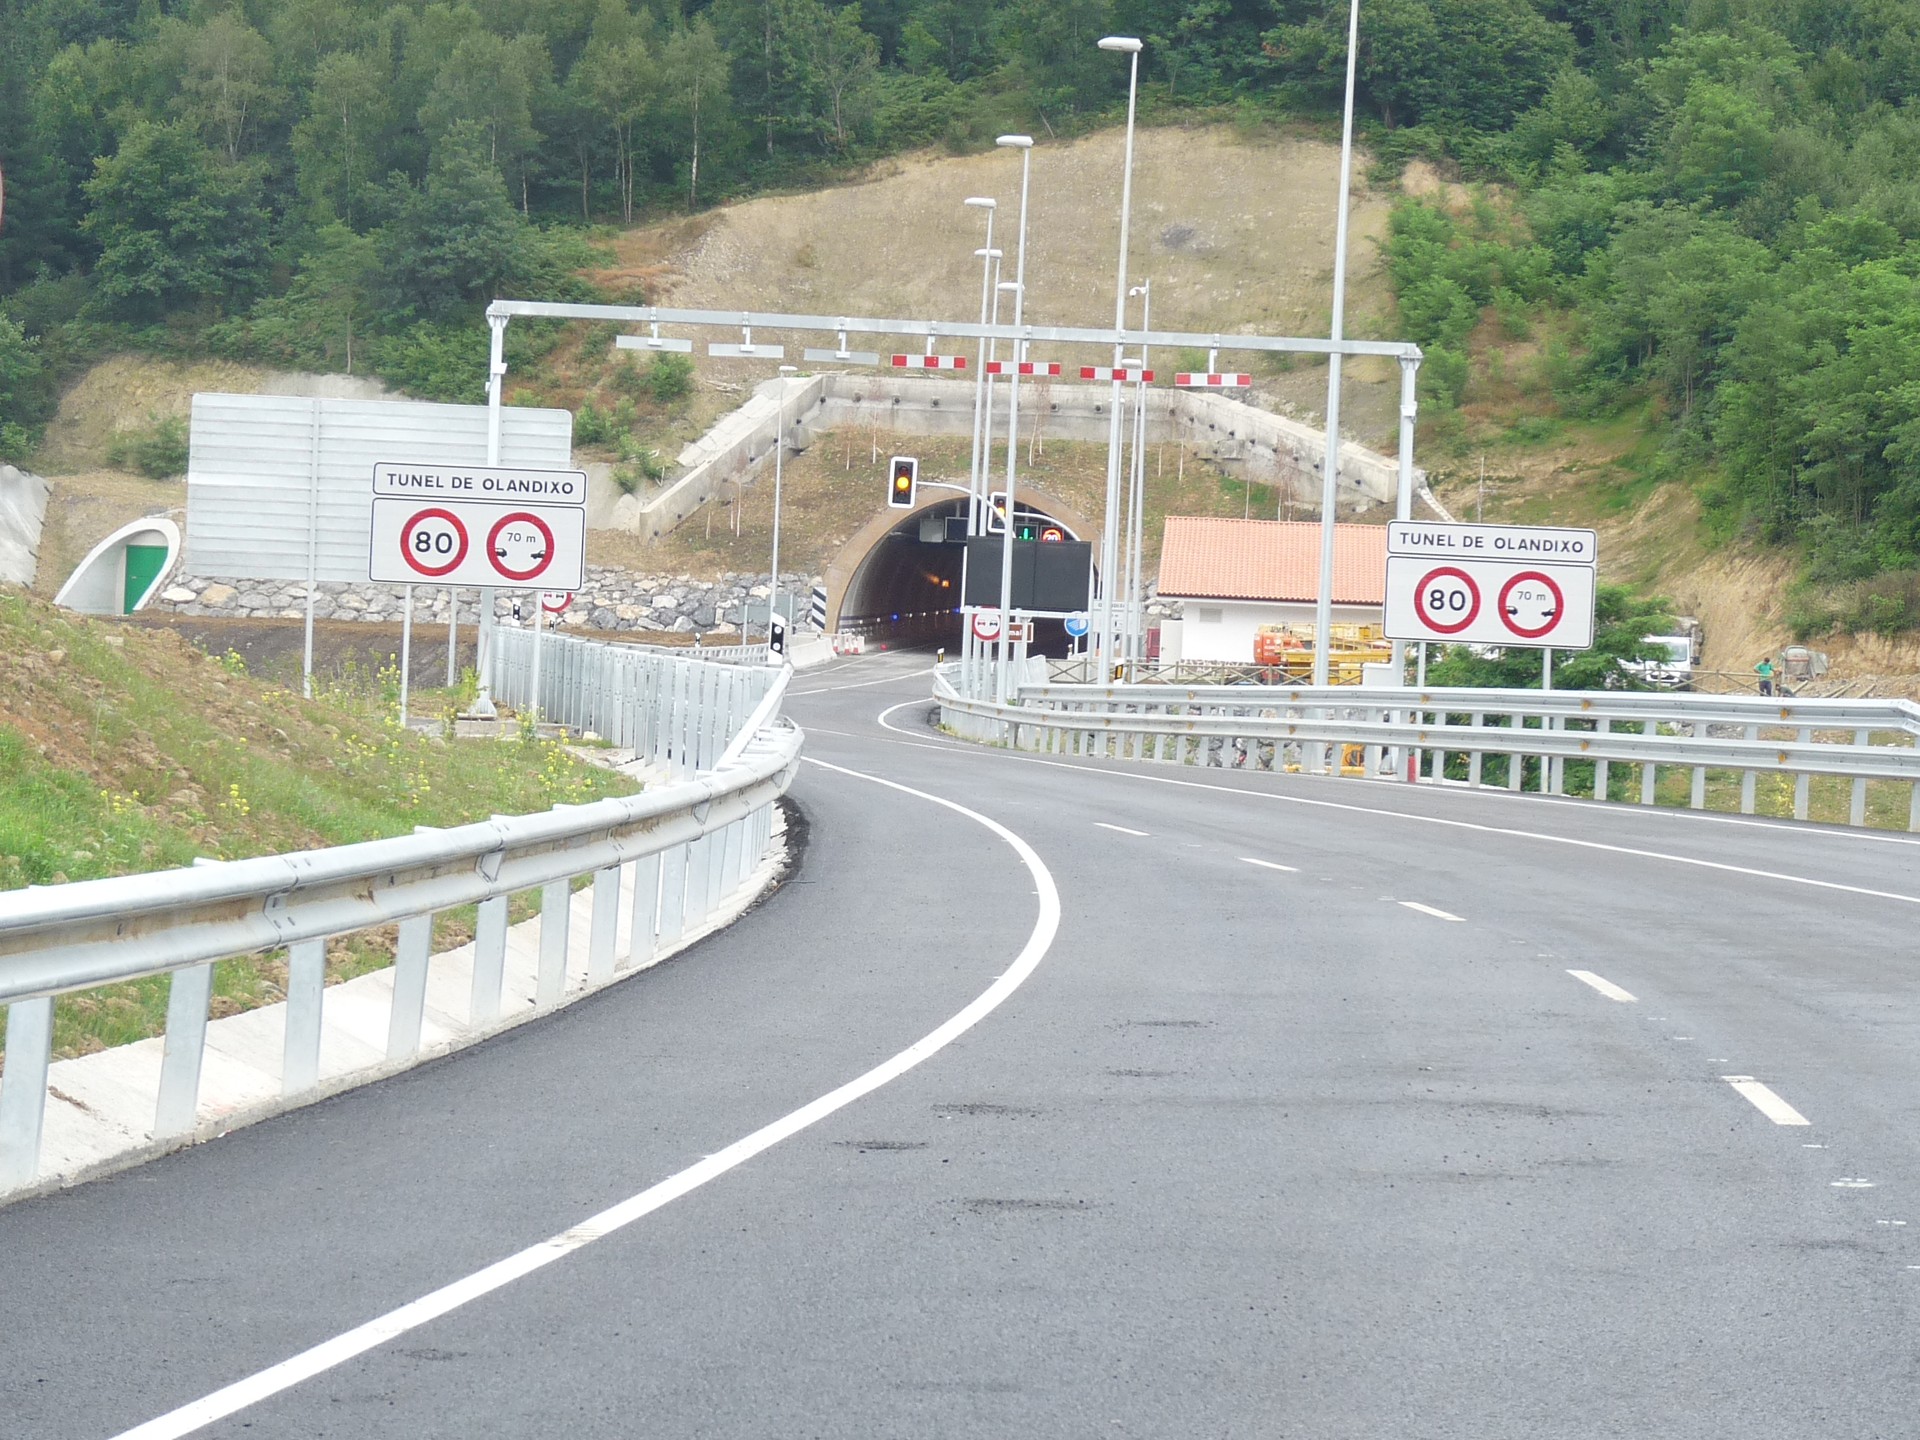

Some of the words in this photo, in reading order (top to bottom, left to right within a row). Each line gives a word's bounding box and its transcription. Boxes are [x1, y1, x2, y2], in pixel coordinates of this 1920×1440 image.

[386, 473, 445, 489] TUNEL
[451, 476, 473, 490] DE
[482, 478, 574, 495] OLANDIXO
[414, 531, 453, 554] 80
[506, 532, 522, 542] 70
[525, 535, 536, 543] m
[1399, 532, 1456, 547] TUNEL
[1462, 535, 1484, 549] DE
[1494, 537, 1584, 553] OLANDIXO
[1429, 589, 1466, 611] 80
[1517, 590, 1532, 601] 70
[1536, 593, 1546, 601] m
